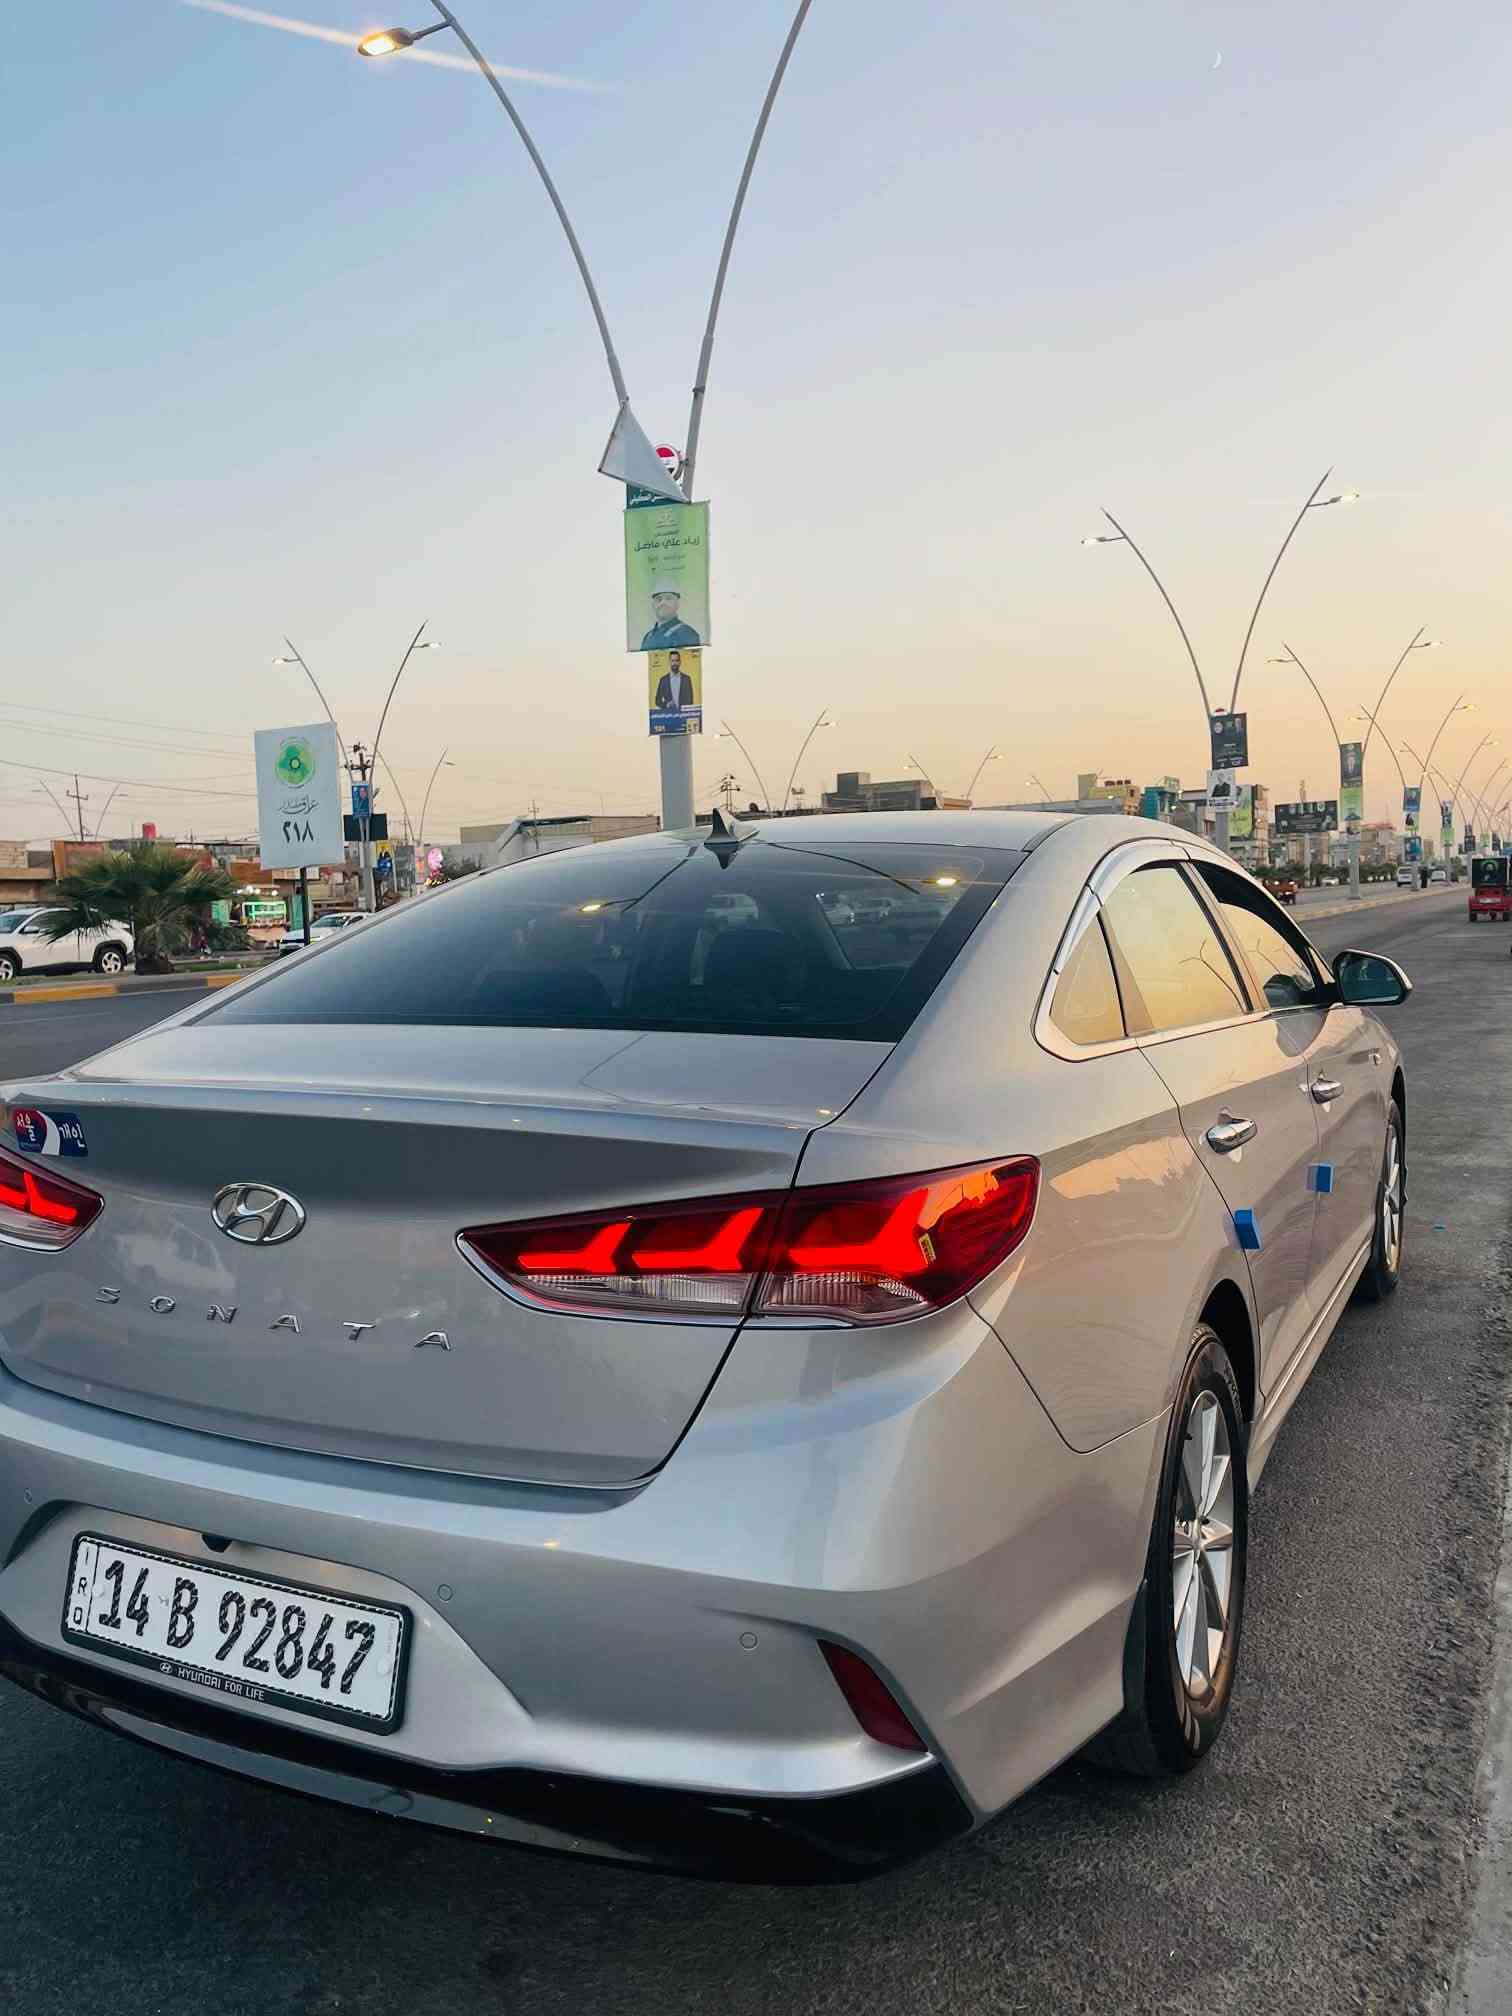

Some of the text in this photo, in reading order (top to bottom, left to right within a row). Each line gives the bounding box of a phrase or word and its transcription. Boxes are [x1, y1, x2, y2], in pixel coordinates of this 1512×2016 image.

[96, 1286, 451, 1352] SONATA
[98, 1560, 376, 1695] 14 B 92847
[178, 1666, 265, 1701] HYUNDAI FOR LIFE
